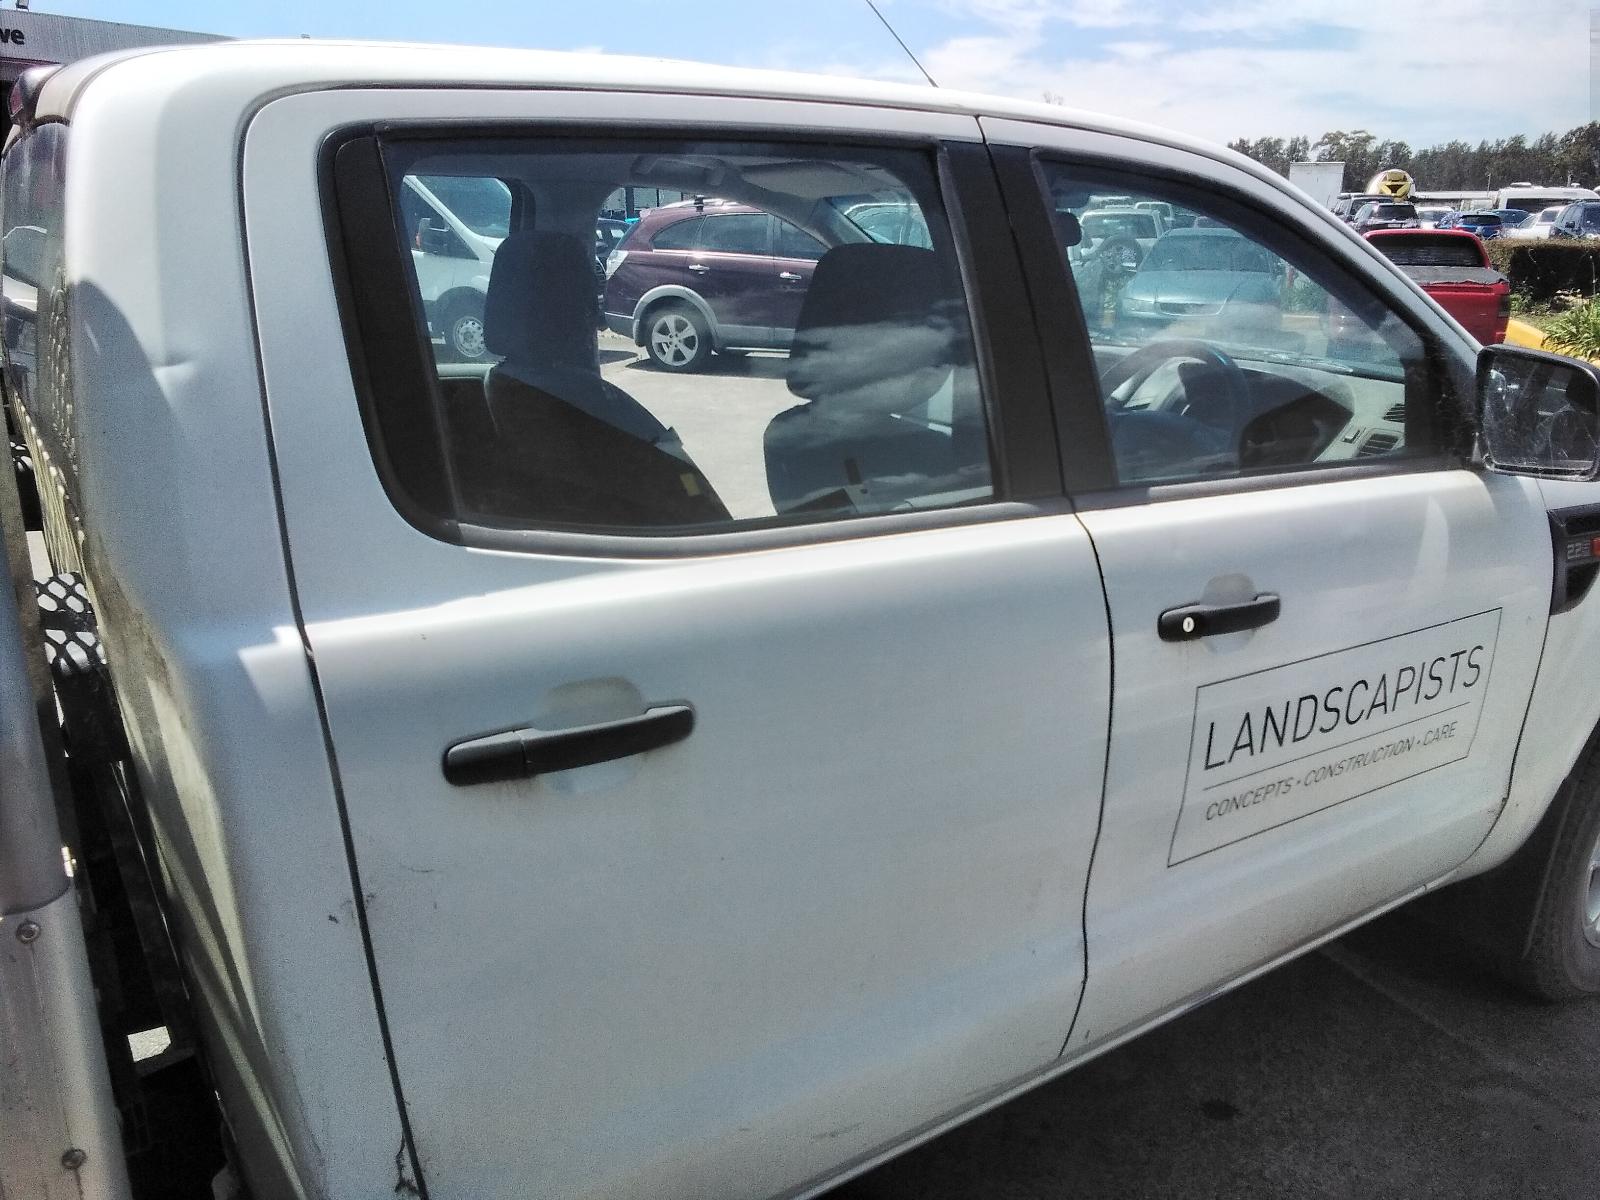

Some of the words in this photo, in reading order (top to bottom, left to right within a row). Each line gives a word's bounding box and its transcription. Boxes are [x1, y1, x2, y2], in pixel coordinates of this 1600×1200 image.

[1204, 645, 1484, 770] LANDSCAPISTS
[1206, 776, 1294, 821] CONCEPTS
[1304, 737, 1416, 786] CONSTRUCTION
[1423, 721, 1458, 746] CARE
